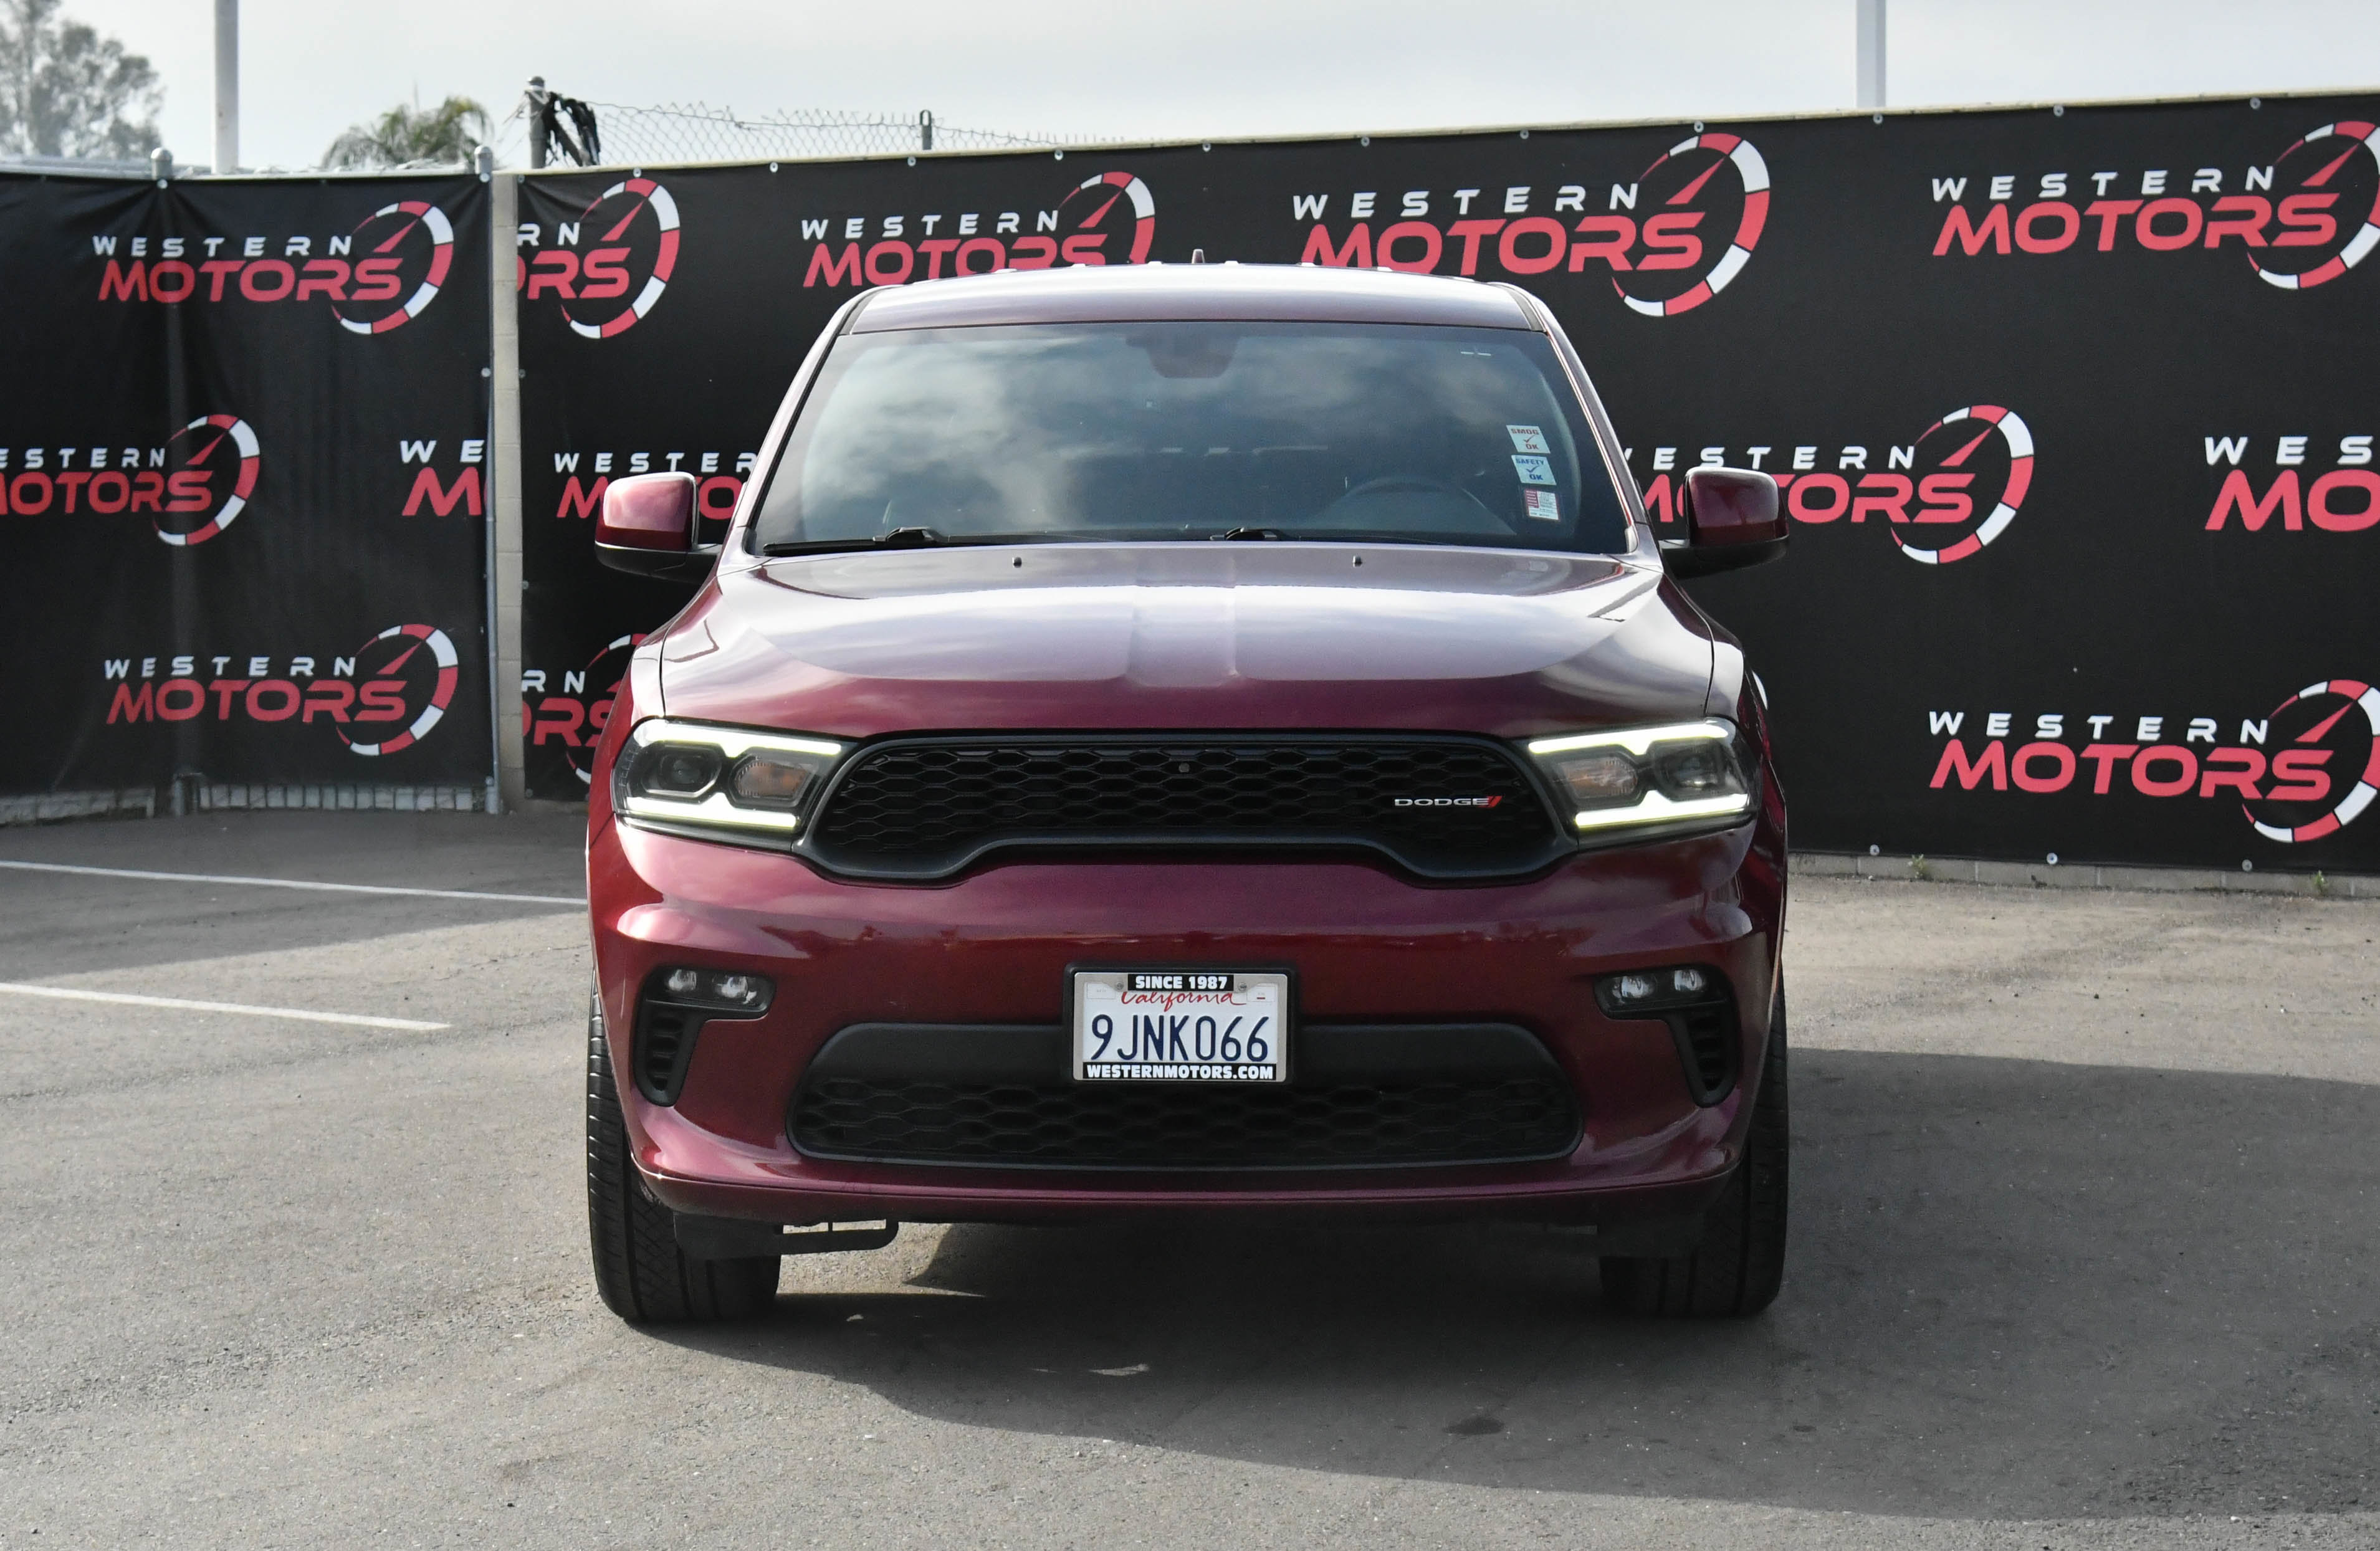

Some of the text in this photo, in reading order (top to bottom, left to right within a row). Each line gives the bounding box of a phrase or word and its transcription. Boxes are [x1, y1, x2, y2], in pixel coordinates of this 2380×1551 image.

[1932, 166, 2274, 201] WESTERN
[1293, 183, 1638, 220] WESTERN
[801, 210, 1059, 240] WESTERN
[1933, 193, 2340, 256] MOTORS
[93, 236, 352, 257] WESTERN
[1301, 212, 1706, 275] MOTORS
[803, 234, 1107, 287] MOTORS
[98, 257, 403, 303] MOTORS
[400, 440, 484, 463] WE
[555, 452, 757, 472] WESTER
[1623, 446, 1915, 470] ESTERN
[2204, 436, 2373, 465] WES
[0, 470, 213, 515] OTORS
[105, 657, 356, 679] WESTERN
[107, 679, 406, 723] MOTORS
[1929, 711, 2268, 743] WESTERN
[1929, 739, 2334, 801] MOTORS
[1395, 798, 1489, 806] DODGE
[1135, 976, 1228, 990] SINCE 1987
[1091, 1014, 1269, 1062] 9JNK066
[1087, 1064, 1273, 1079] WESTERNMOTORS.COM
